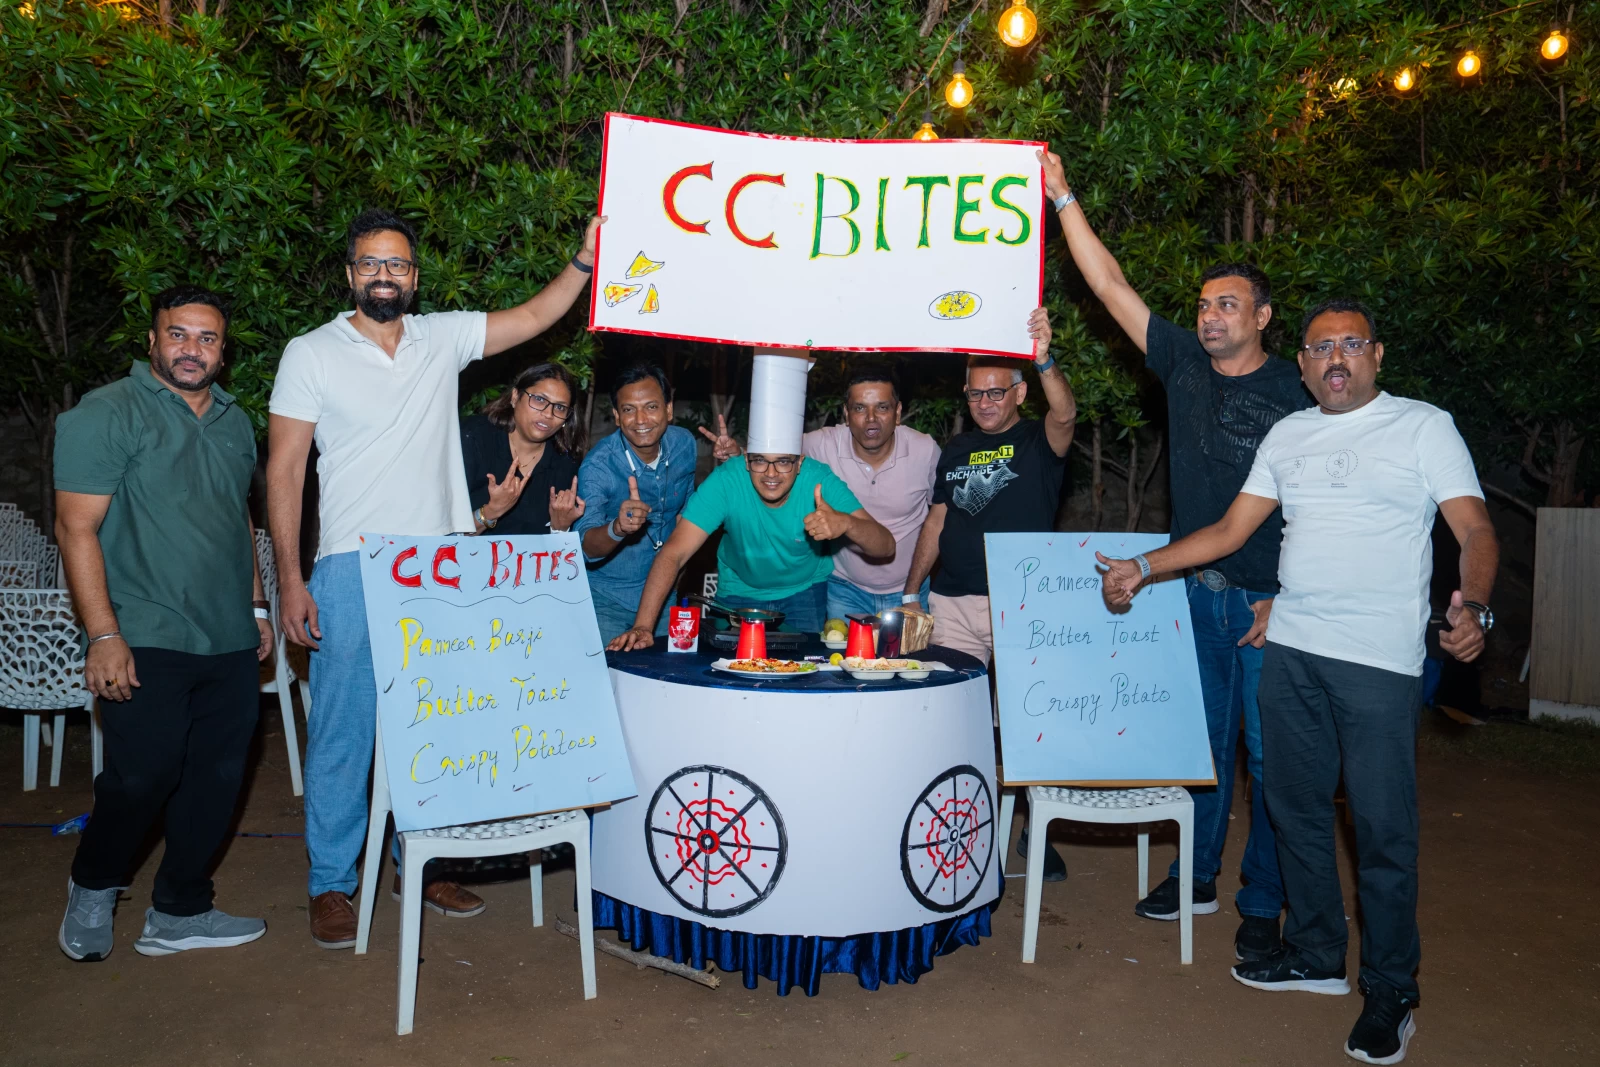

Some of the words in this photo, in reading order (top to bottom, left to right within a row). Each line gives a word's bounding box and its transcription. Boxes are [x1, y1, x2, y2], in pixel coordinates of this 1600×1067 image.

[809, 171, 1033, 260] BITES
[970, 446, 1013, 464] ARMANI
[481, 540, 580, 591] BITES
[1014, 556, 1100, 604] Panneer
[395, 617, 477, 671] Panneer
[1025, 619, 1093, 650] Butter
[1106, 620, 1160, 646] Toast
[407, 677, 499, 728] Butter
[510, 673, 571, 711] Toast
[1023, 680, 1104, 725] Crispy
[1110, 672, 1171, 712] Potato
[410, 743, 500, 787] Crispy
[512, 725, 598, 772] Potatoes
